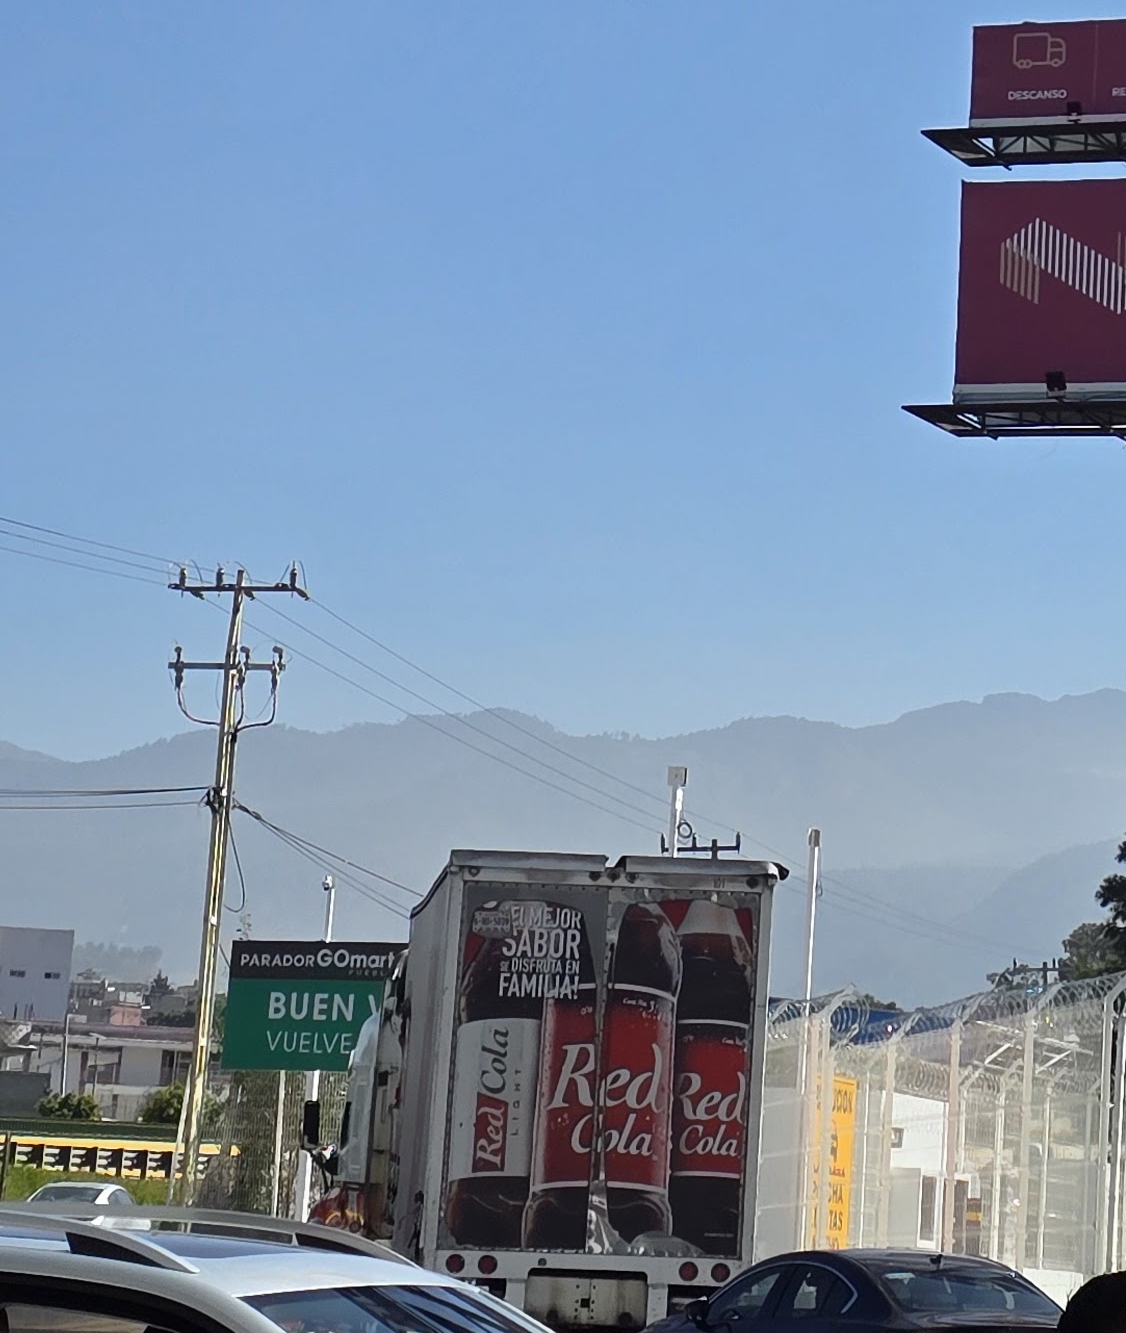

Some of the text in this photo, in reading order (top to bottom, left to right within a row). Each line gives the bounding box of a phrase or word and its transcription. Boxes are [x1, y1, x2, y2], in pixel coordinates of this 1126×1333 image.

[1008, 89, 1068, 100] DESCANSO
[529, 906, 582, 930] MEJOR
[240, 948, 395, 969] PARADOR GOmart
[502, 926, 581, 960] SABOR
[511, 957, 562, 974] DISFRUTA
[566, 959, 580, 976] EN
[268, 991, 355, 1022] BUEN
[266, 1030, 353, 1055] VUELVE
[546, 1042, 662, 1114] Red
[475, 1026, 510, 1169] Red Cola
[510, 1068, 523, 1136] LIGHT
[679, 1071, 745, 1125] Red
[570, 1113, 655, 1156] Cola
[679, 1123, 740, 1157] Cola
